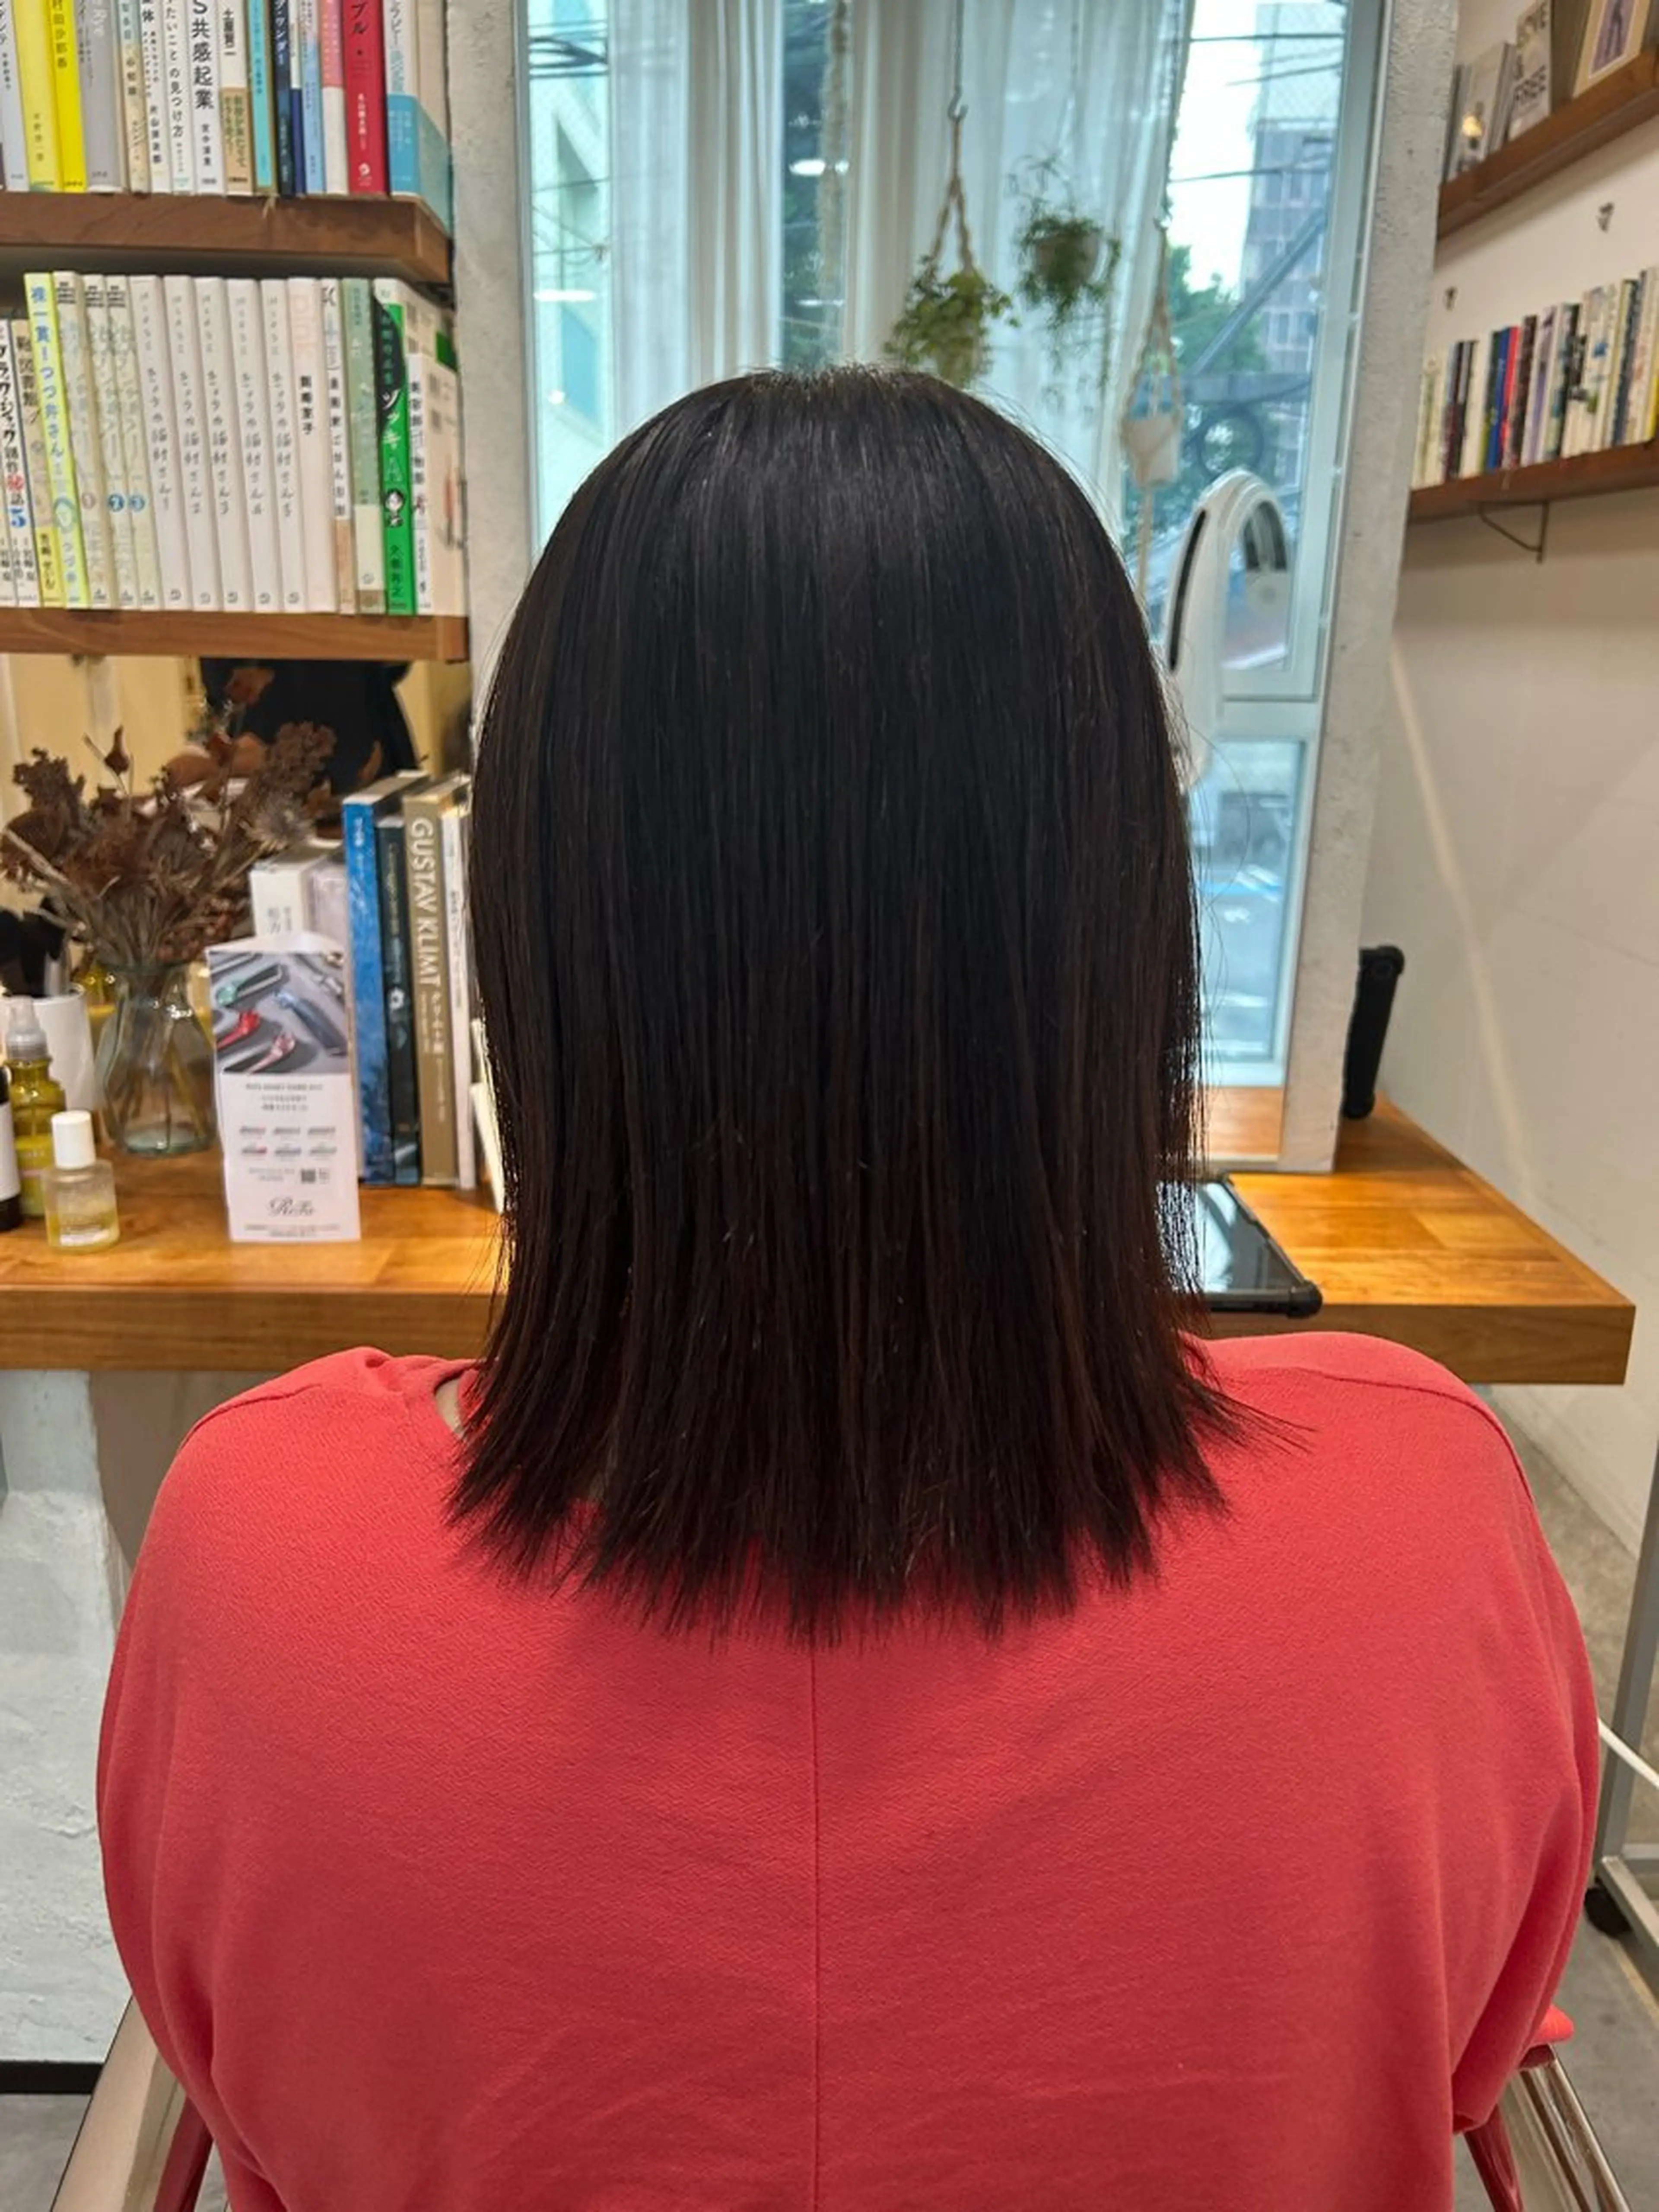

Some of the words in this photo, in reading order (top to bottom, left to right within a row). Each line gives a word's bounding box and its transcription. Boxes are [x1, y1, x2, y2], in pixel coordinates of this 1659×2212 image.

[166, 0, 184, 138] たいことの見つけ方
[411, 817, 438, 914] GUSTAV
[416, 917, 441, 987] KLIMT
